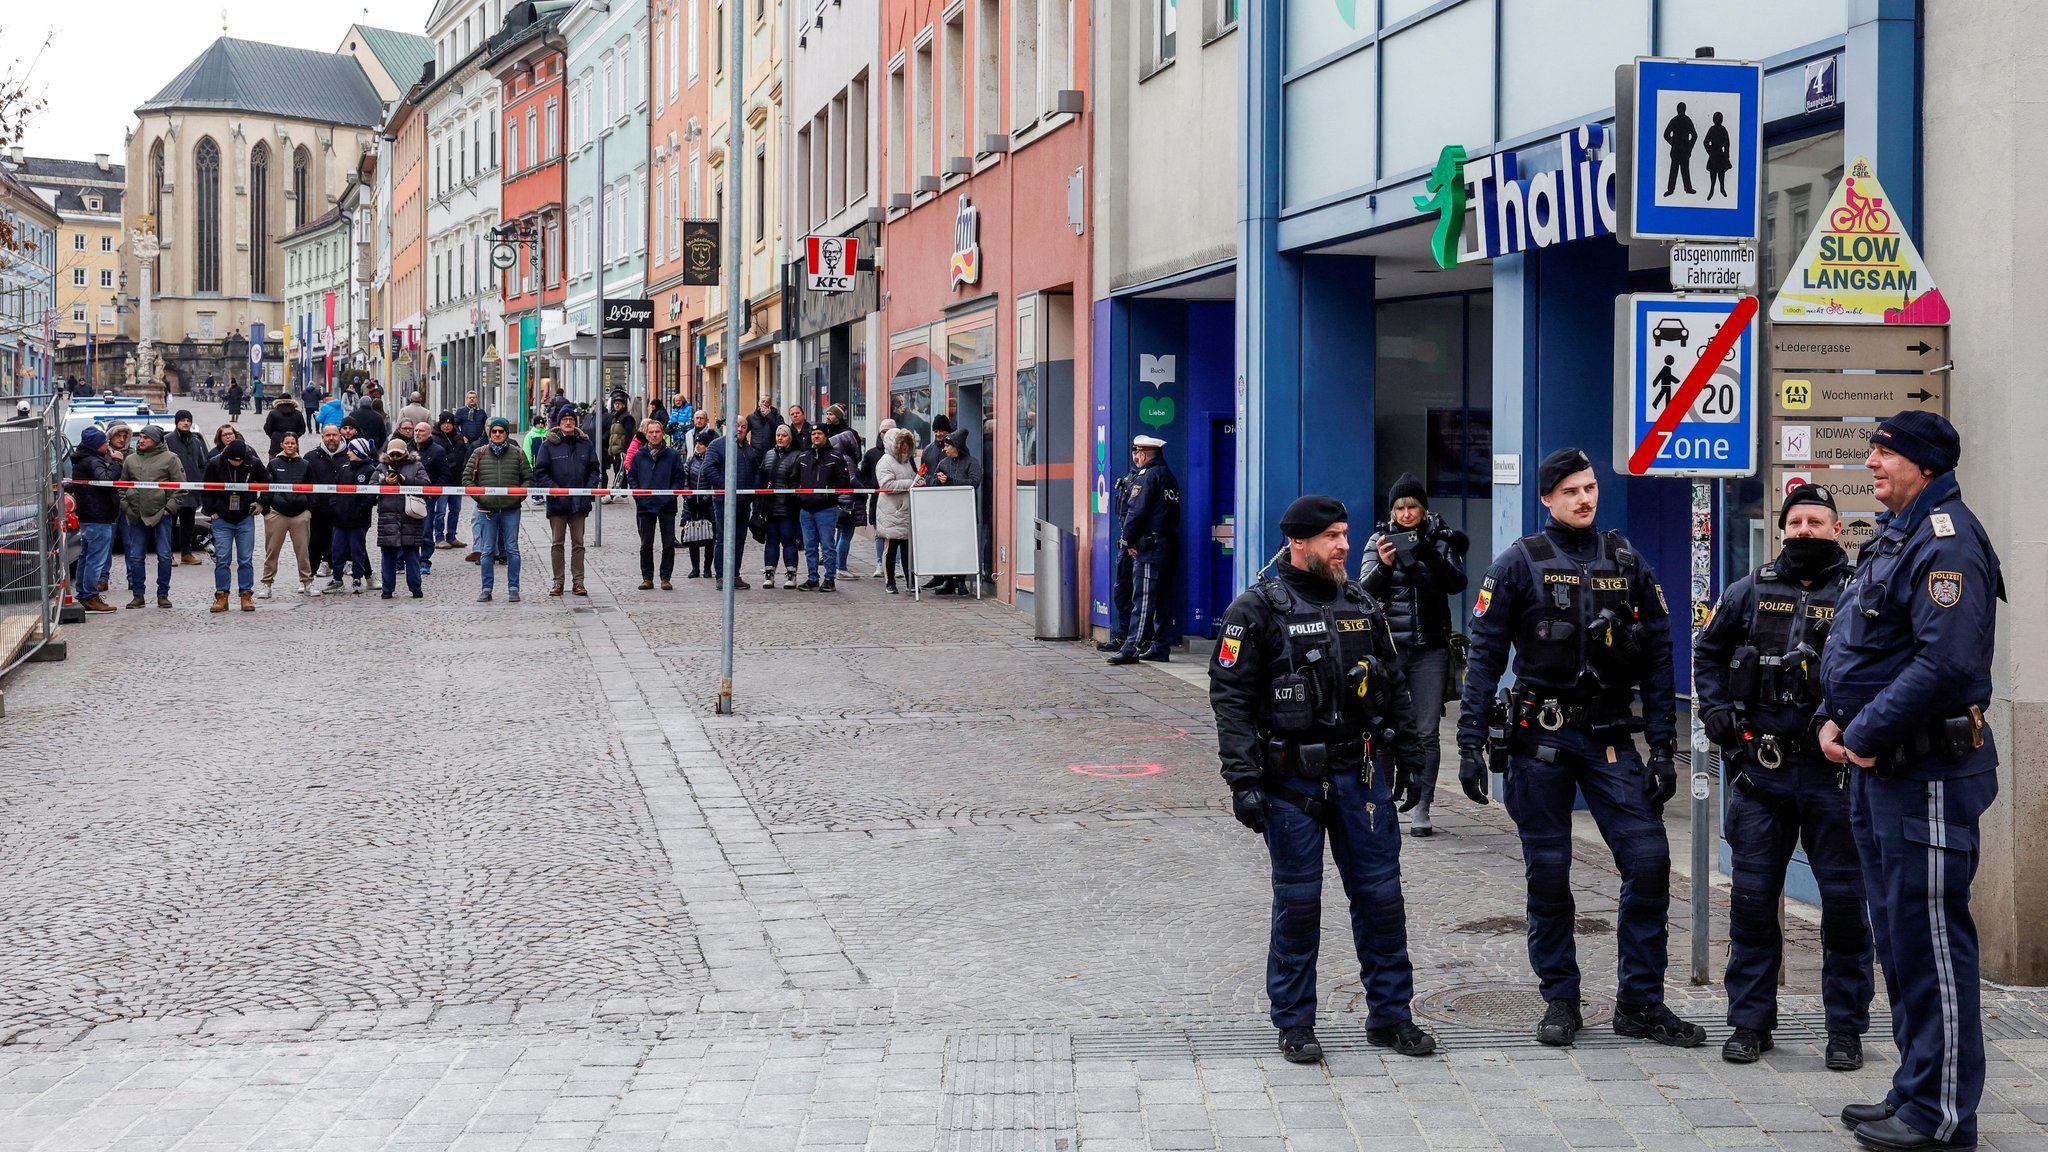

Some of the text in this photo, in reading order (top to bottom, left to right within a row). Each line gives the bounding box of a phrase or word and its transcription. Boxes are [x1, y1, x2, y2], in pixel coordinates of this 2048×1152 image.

[1813, 65, 1824, 94] 4
[1819, 236, 1900, 263] SLOW
[1673, 248, 1754, 266] ausgenommen
[1687, 267, 1741, 285] Fahrräder
[1803, 268, 1917, 291] LANGSAM
[815, 277, 848, 289] KFC
[606, 305, 621, 321] Le
[620, 305, 652, 322] Burger
[1781, 342, 1851, 355] Lederergasse
[1702, 384, 1734, 415] 20
[1821, 390, 1894, 401] Wochenmarkt
[1815, 428, 1856, 439] KIDWAY
[1858, 428, 1875, 441] Spi
[1656, 431, 1730, 460] Zone
[1815, 448, 1832, 459] und
[1823, 484, 1874, 495] O-QUAR
[1852, 527, 1874, 537] Sitzg
[1844, 541, 1860, 550] Wei
[1544, 574, 1580, 584] POLIZEI
[1932, 573, 1960, 581] POLIZEI
[1599, 581, 1622, 589] SIG
[1758, 601, 1794, 612] POLIZEI
[1225, 623, 1244, 637] K-07
[1288, 621, 1327, 635] POLIZEI
[1343, 622, 1364, 630] SIG
[1223, 644, 1238, 654] SIG
